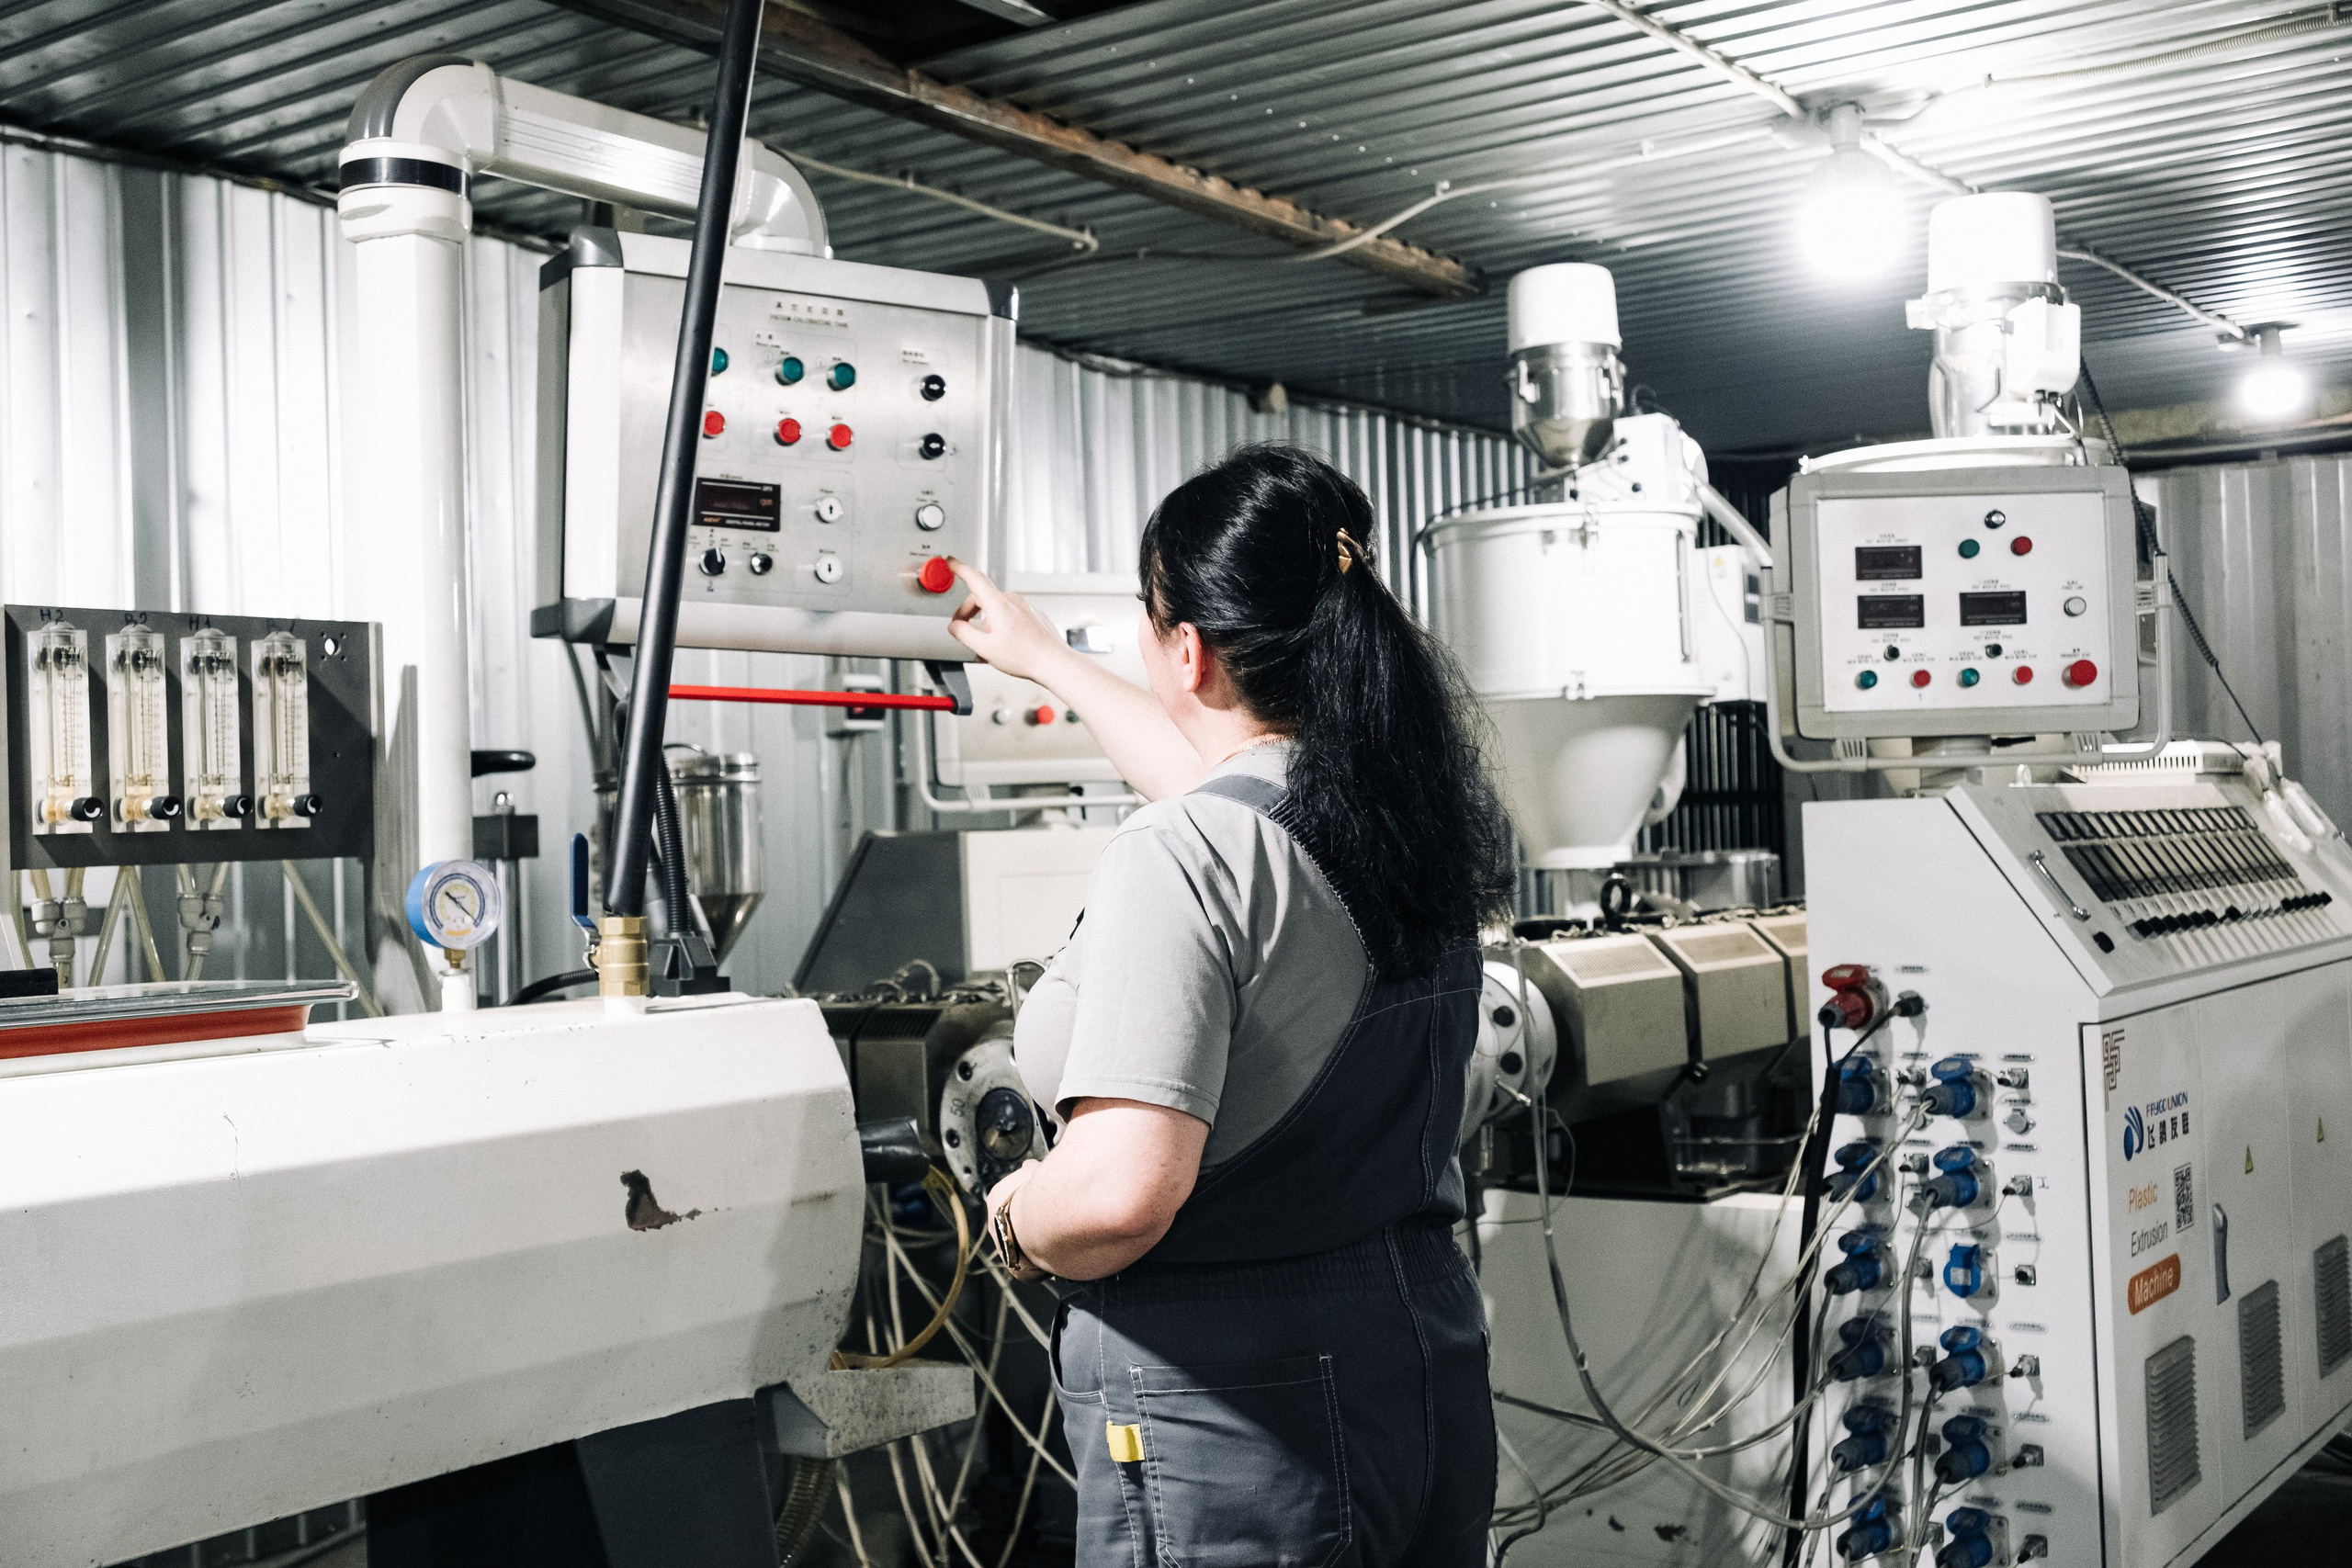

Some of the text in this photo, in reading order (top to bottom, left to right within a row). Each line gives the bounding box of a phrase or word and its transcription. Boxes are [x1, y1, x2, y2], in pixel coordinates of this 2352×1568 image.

[2167, 1090, 2188, 1111] UNION
[2129, 1179, 2157, 1213] Plastic
[2131, 1221, 2168, 1258] Extrusion
[2134, 1266, 2174, 1307] Machine
